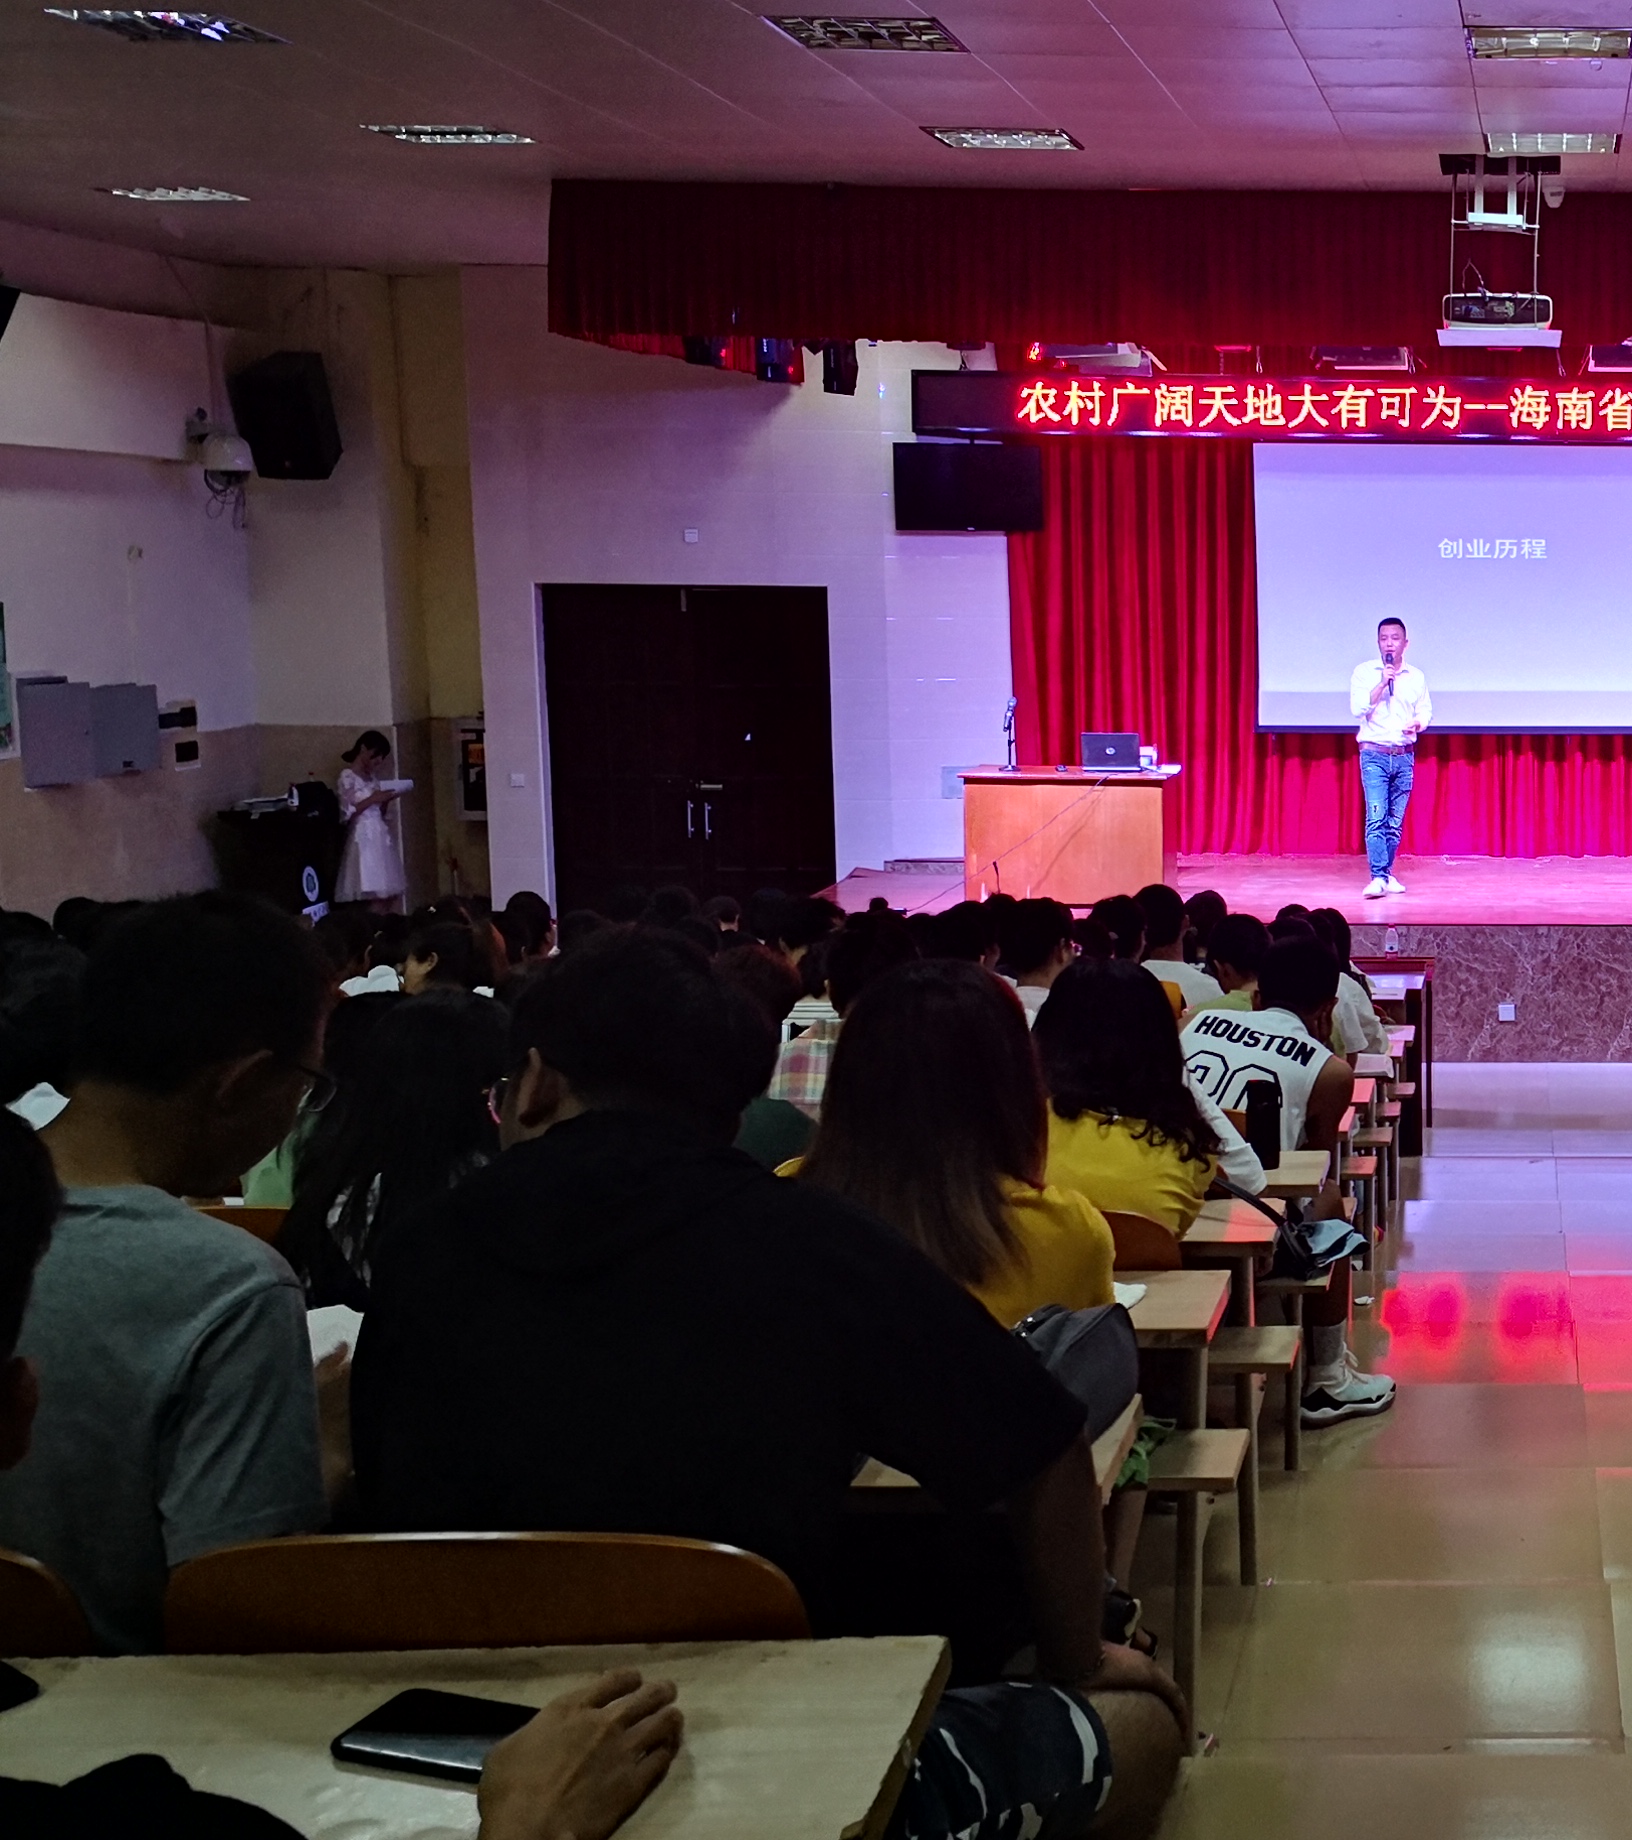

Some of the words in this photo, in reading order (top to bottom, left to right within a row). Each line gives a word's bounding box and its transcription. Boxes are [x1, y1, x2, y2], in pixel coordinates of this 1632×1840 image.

[1437, 538, 1548, 560] 创业历程
[1194, 1015, 1317, 1067] HOUSTON
